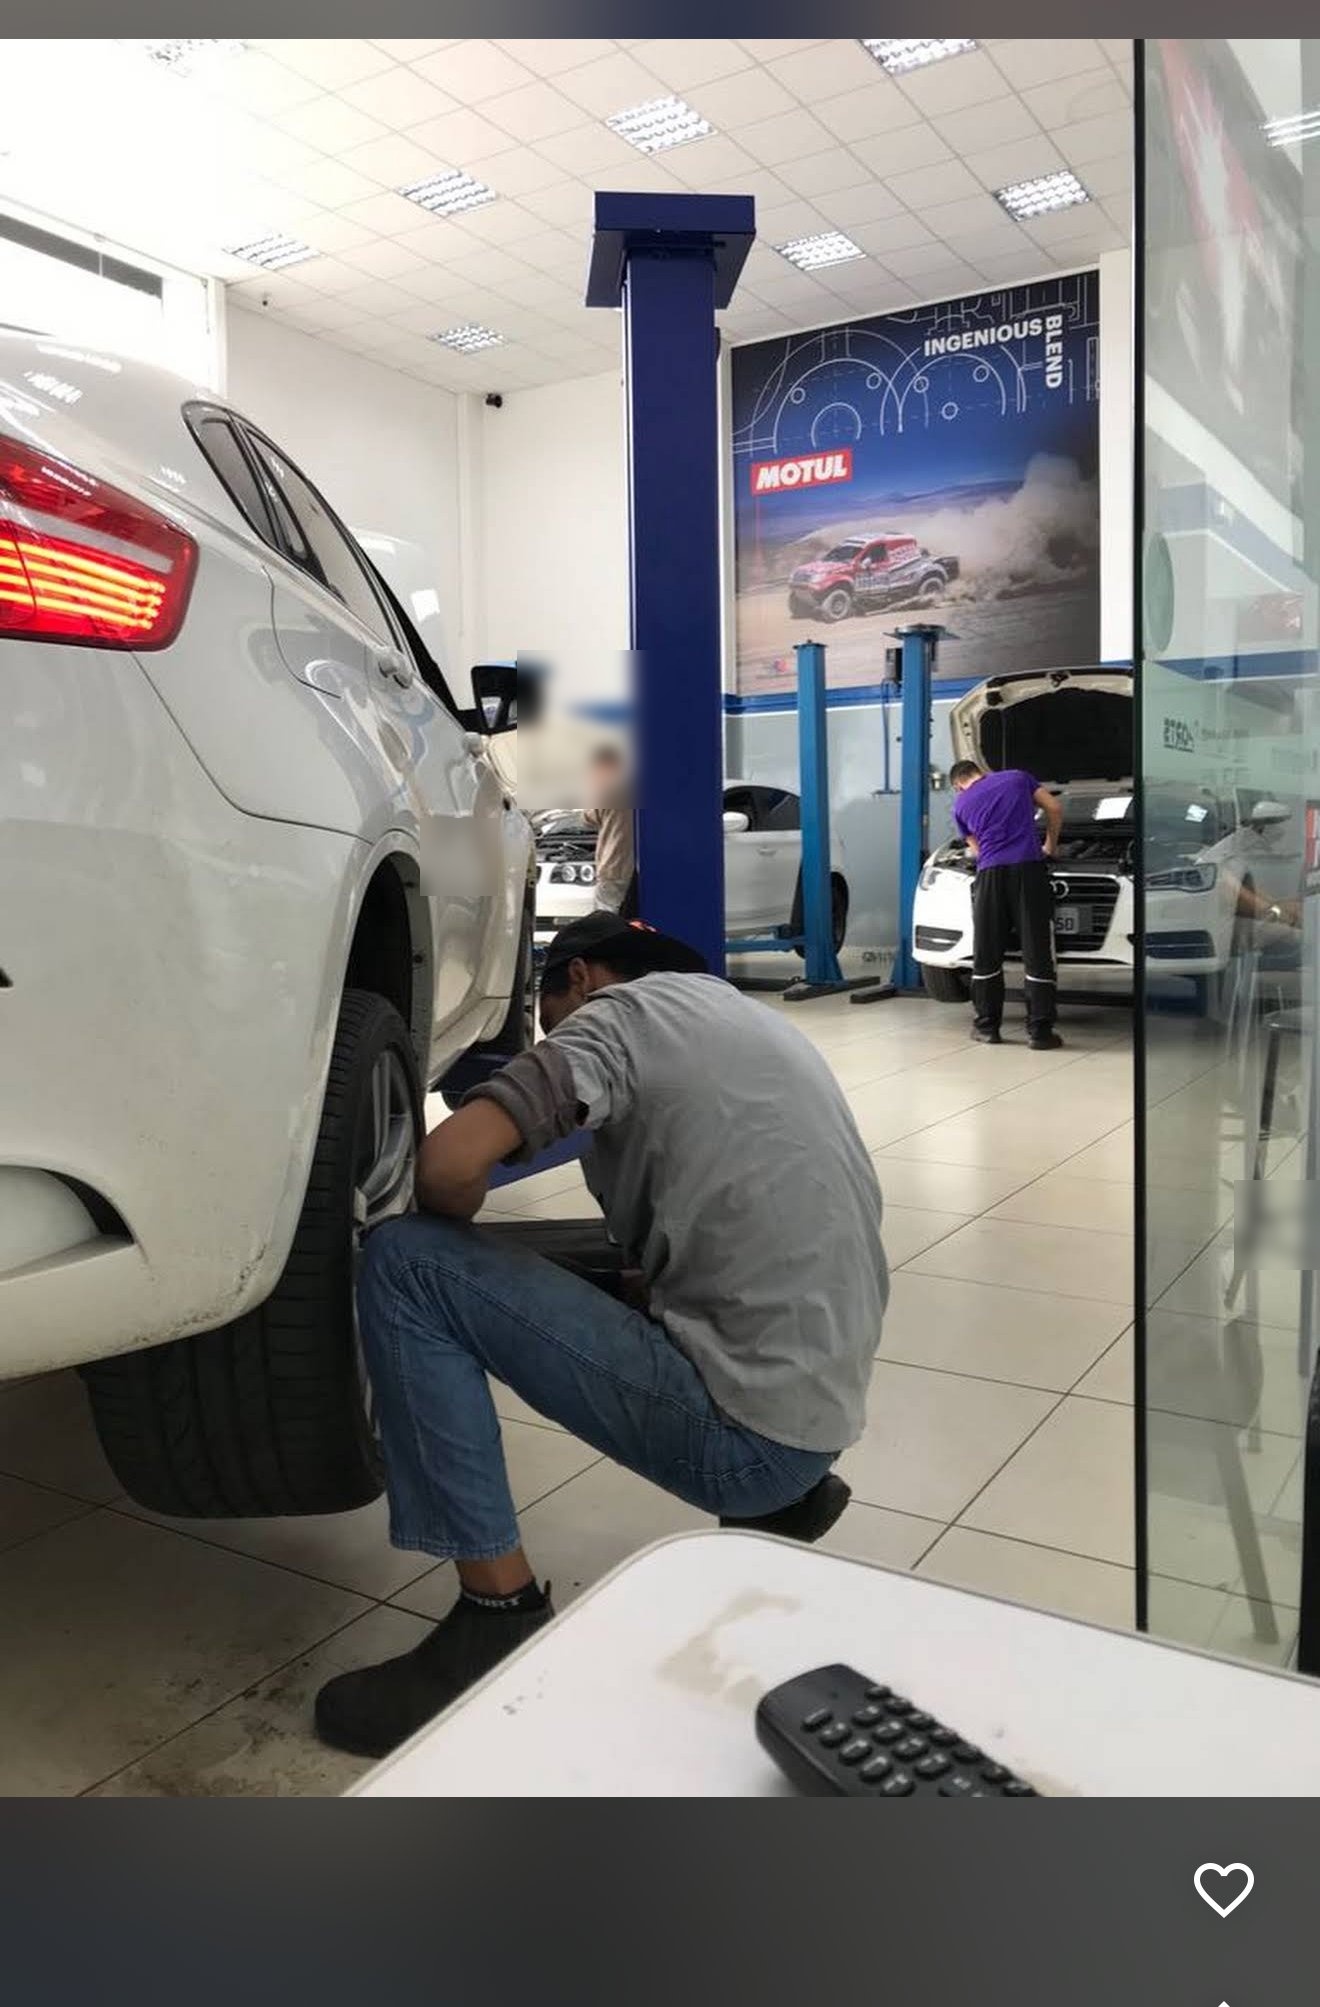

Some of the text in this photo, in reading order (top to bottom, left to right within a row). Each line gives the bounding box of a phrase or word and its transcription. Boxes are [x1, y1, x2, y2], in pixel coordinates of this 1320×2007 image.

[923, 318, 1044, 357] INGENIOUS
[1045, 313, 1064, 389] BLEND
[755, 453, 849, 491] MOTUL
